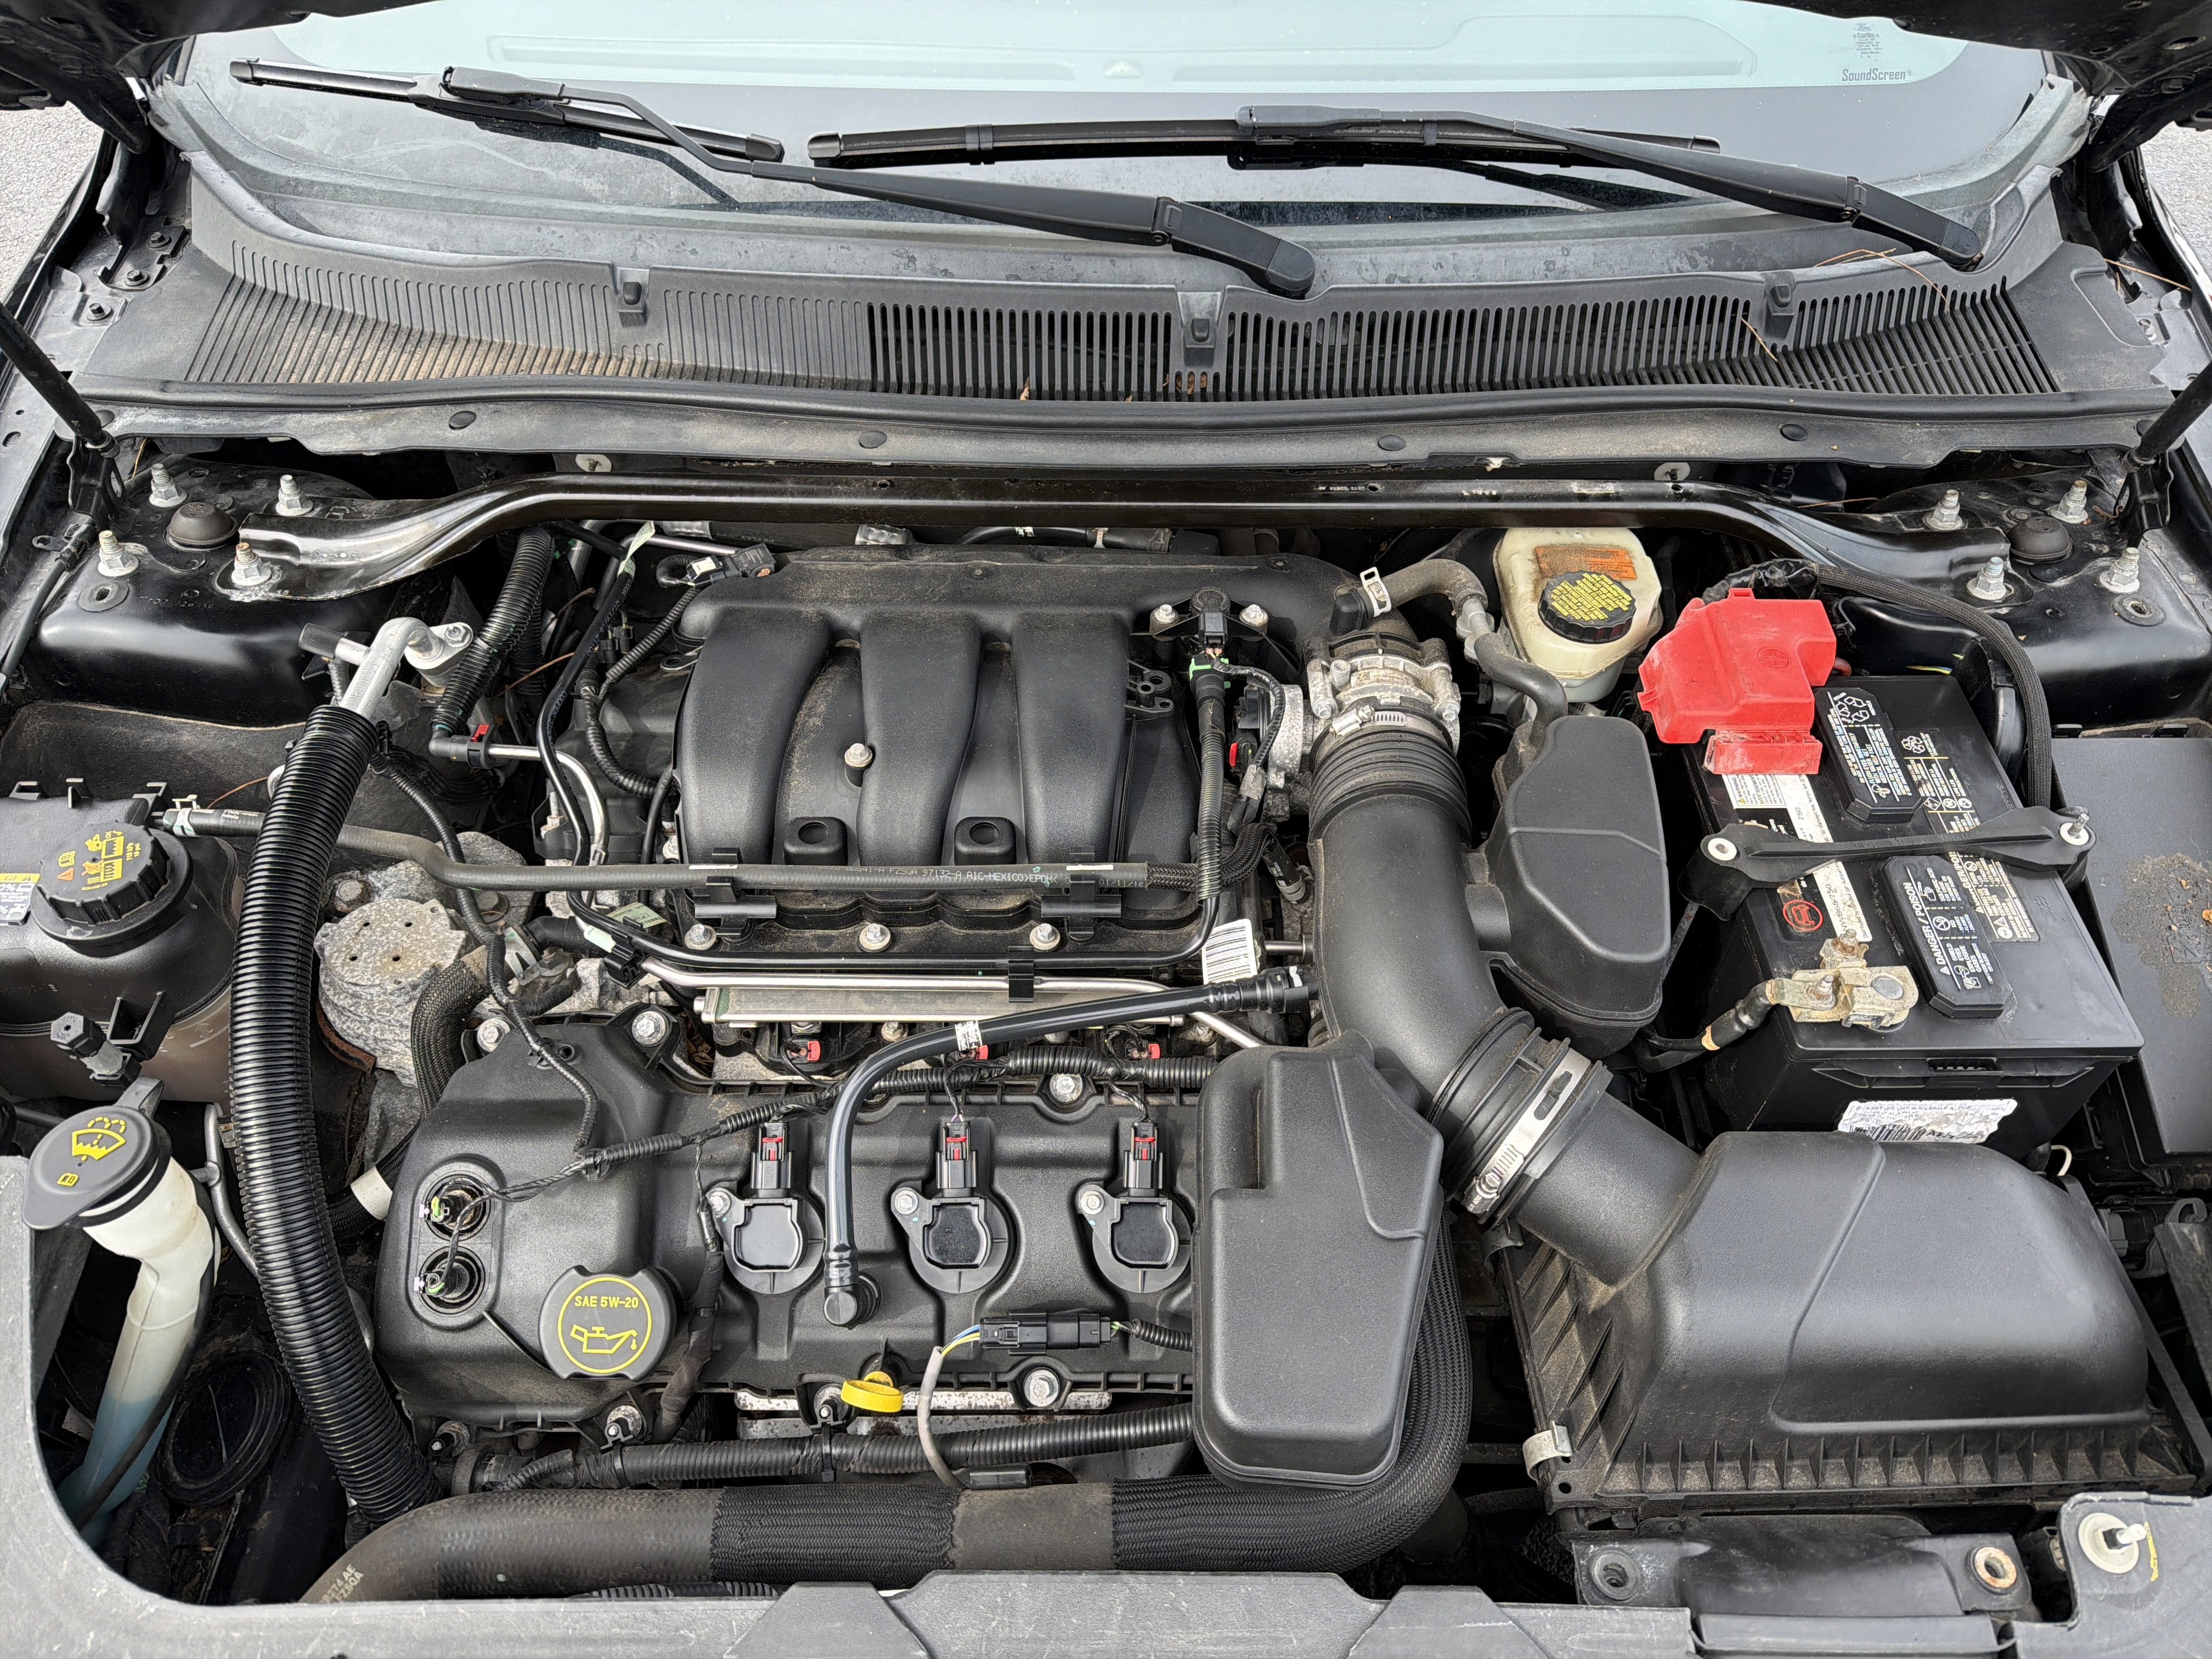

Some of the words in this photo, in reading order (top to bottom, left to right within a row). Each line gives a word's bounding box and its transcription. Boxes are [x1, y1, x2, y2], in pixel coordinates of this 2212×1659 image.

[1865, 744, 1874, 753] FAST
[1860, 759, 1869, 769] EYES
[1866, 759, 1876, 771] WATER
[1864, 771, 1875, 783] FLUSH
[1795, 807, 1805, 821] 750
[922, 869, 962, 878] 97132-A
[1926, 868, 1936, 878] ACID
[1931, 879, 1945, 901] SULFURIC
[1904, 883, 1925, 915] POISON
[1922, 926, 1946, 963] DANGER
[1945, 944, 1958, 960] SHIELD
[1954, 948, 1964, 960] EYES
[1959, 946, 1976, 972] EXPLOSIVE
[1970, 955, 1982, 972] GASES
[574, 1295, 598, 1307] SAE
[600, 1296, 639, 1308] 5W-20
